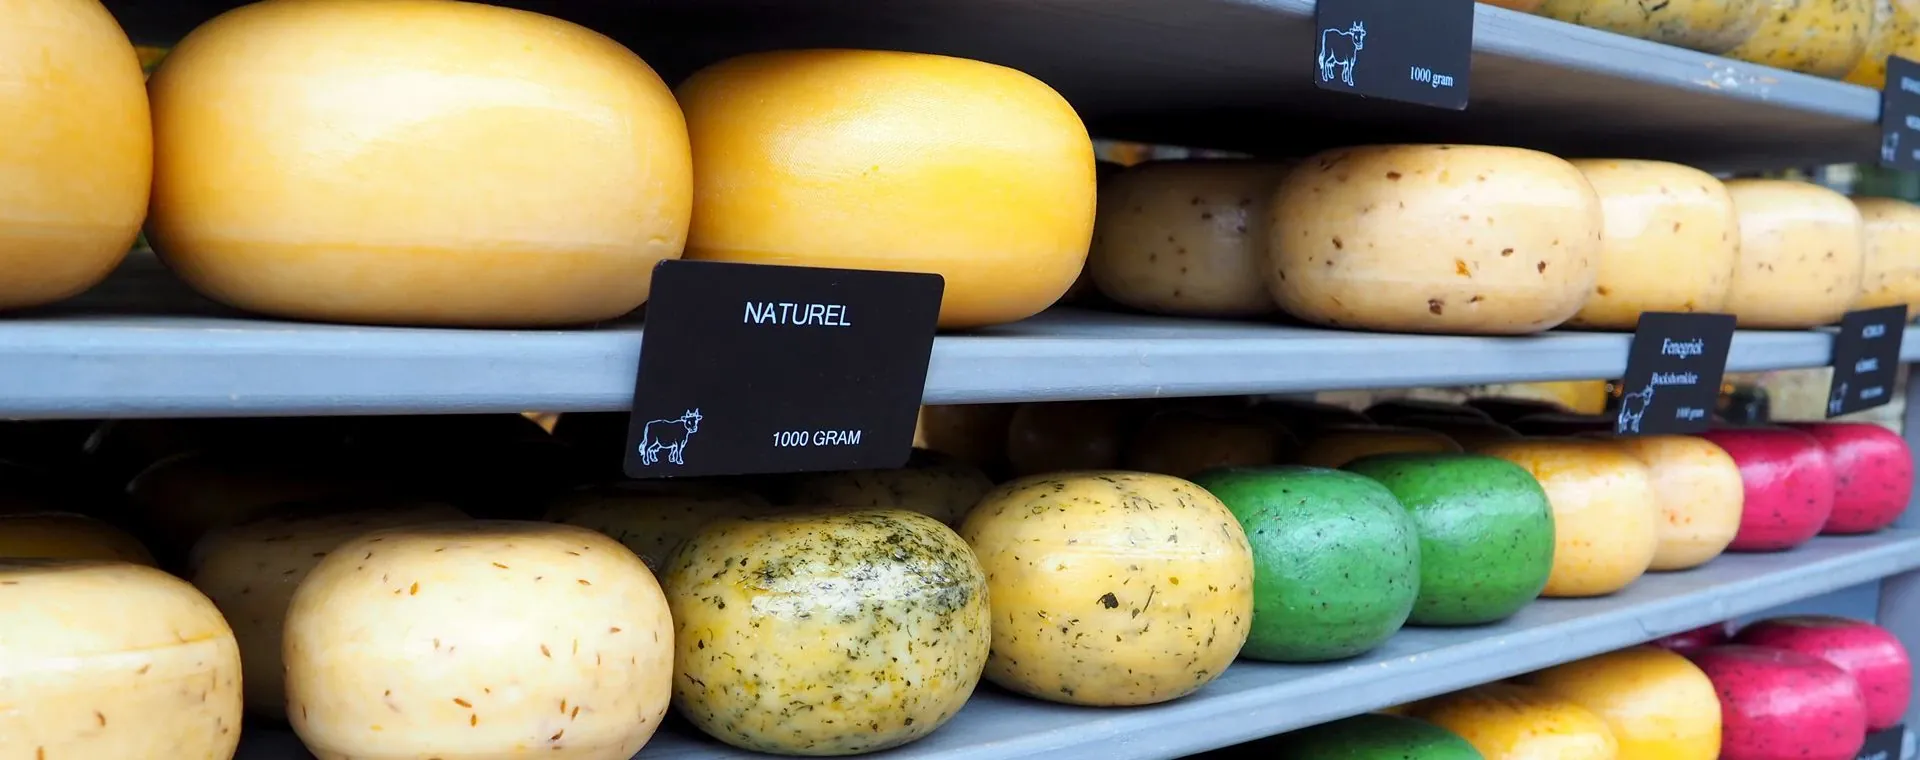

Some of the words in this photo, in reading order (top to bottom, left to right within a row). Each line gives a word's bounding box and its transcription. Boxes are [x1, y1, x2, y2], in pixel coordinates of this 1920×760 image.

[1410, 66, 1431, 83] 1000
[1432, 73, 1454, 88] gram
[744, 301, 851, 327] NATUREL
[773, 431, 810, 447] 1000
[813, 429, 862, 447] GRAM
